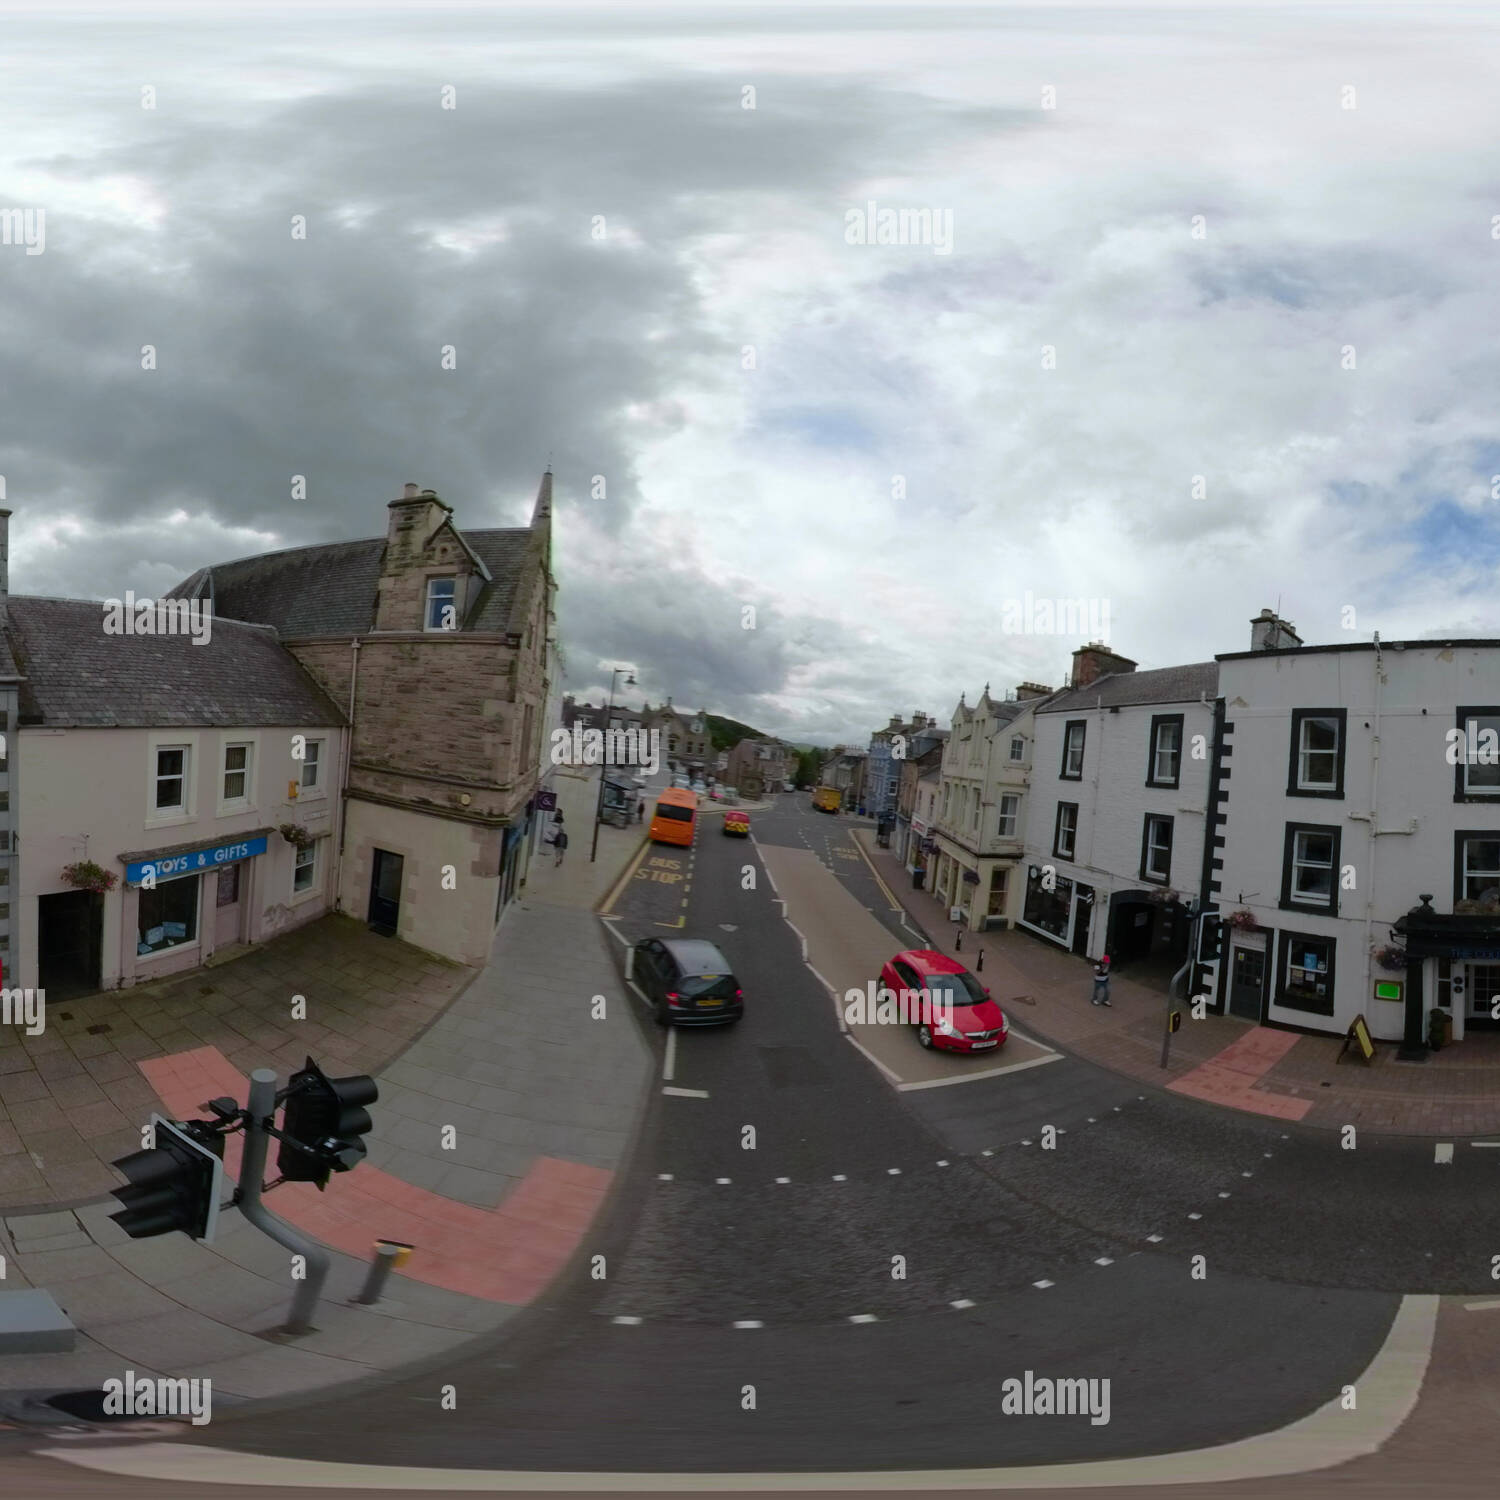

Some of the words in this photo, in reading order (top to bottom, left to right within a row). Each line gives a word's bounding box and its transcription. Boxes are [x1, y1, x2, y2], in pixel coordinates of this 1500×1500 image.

[155, 857, 188, 874] TOYS
[197, 854, 206, 866] &
[214, 843, 248, 862] GIFTS
[649, 857, 680, 870] BUS
[634, 868, 683, 884] STOP
